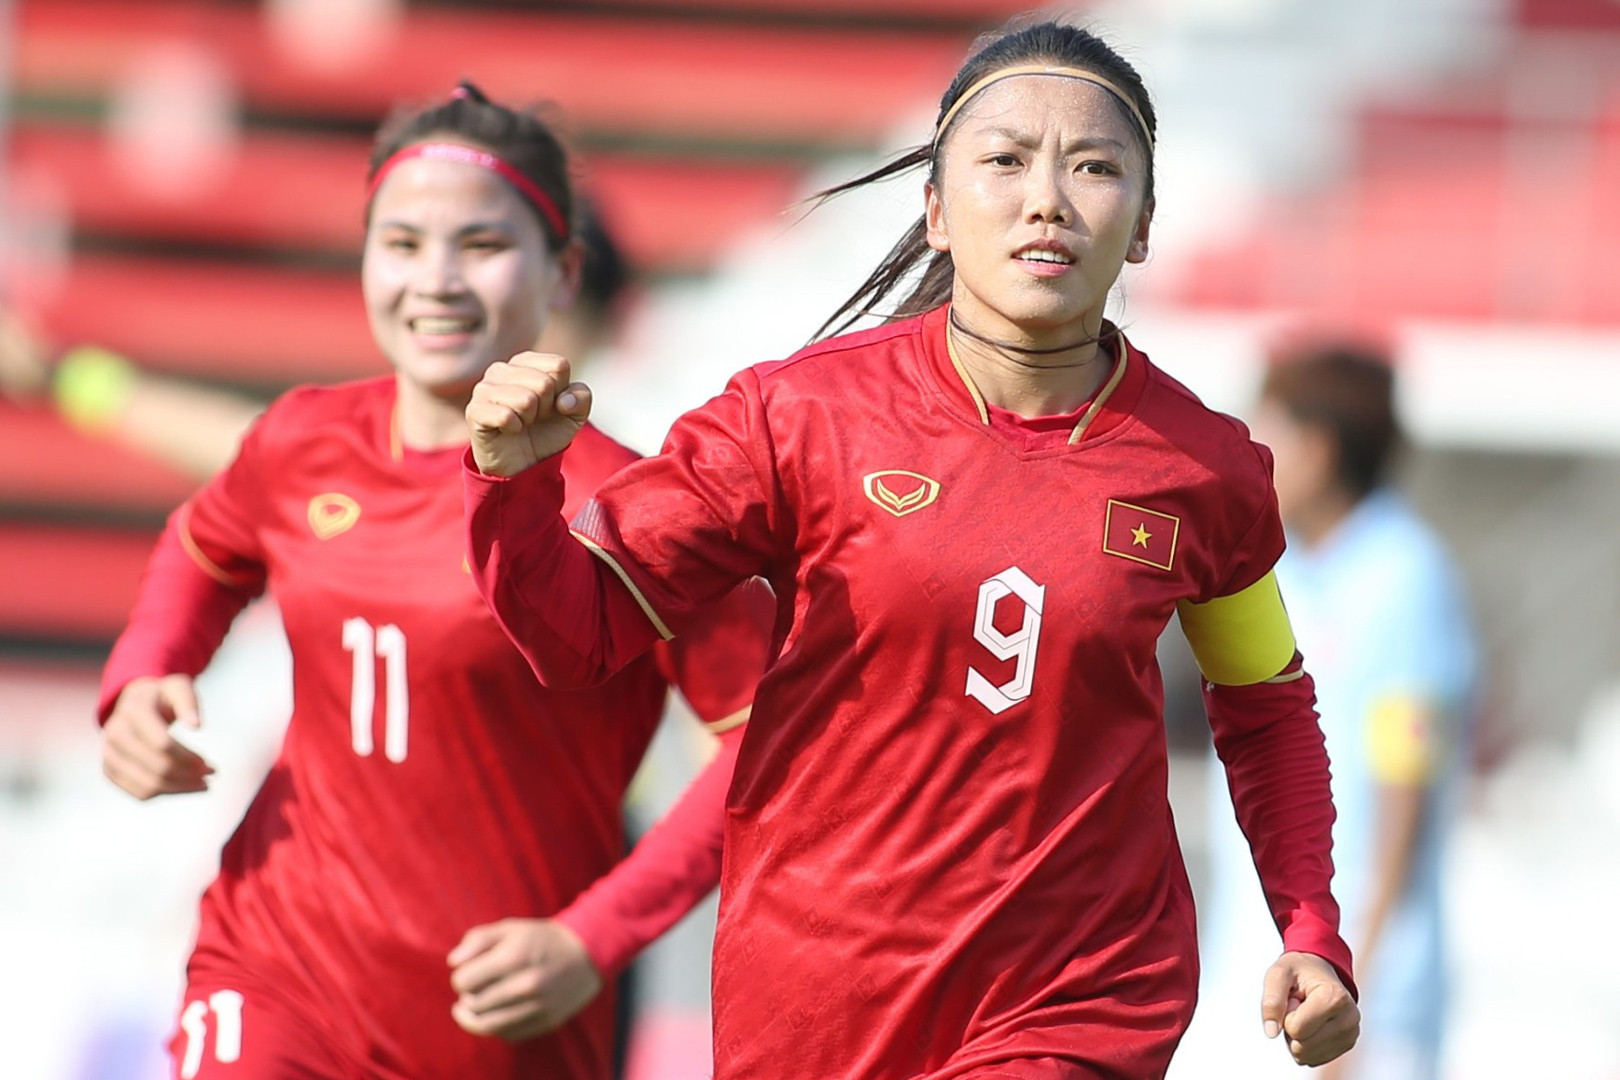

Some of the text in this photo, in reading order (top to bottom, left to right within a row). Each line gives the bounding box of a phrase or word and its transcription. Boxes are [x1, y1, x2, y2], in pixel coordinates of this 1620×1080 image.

[341, 616, 409, 764] 11
[965, 566, 1046, 714] 9
[180, 988, 245, 1080] 11
